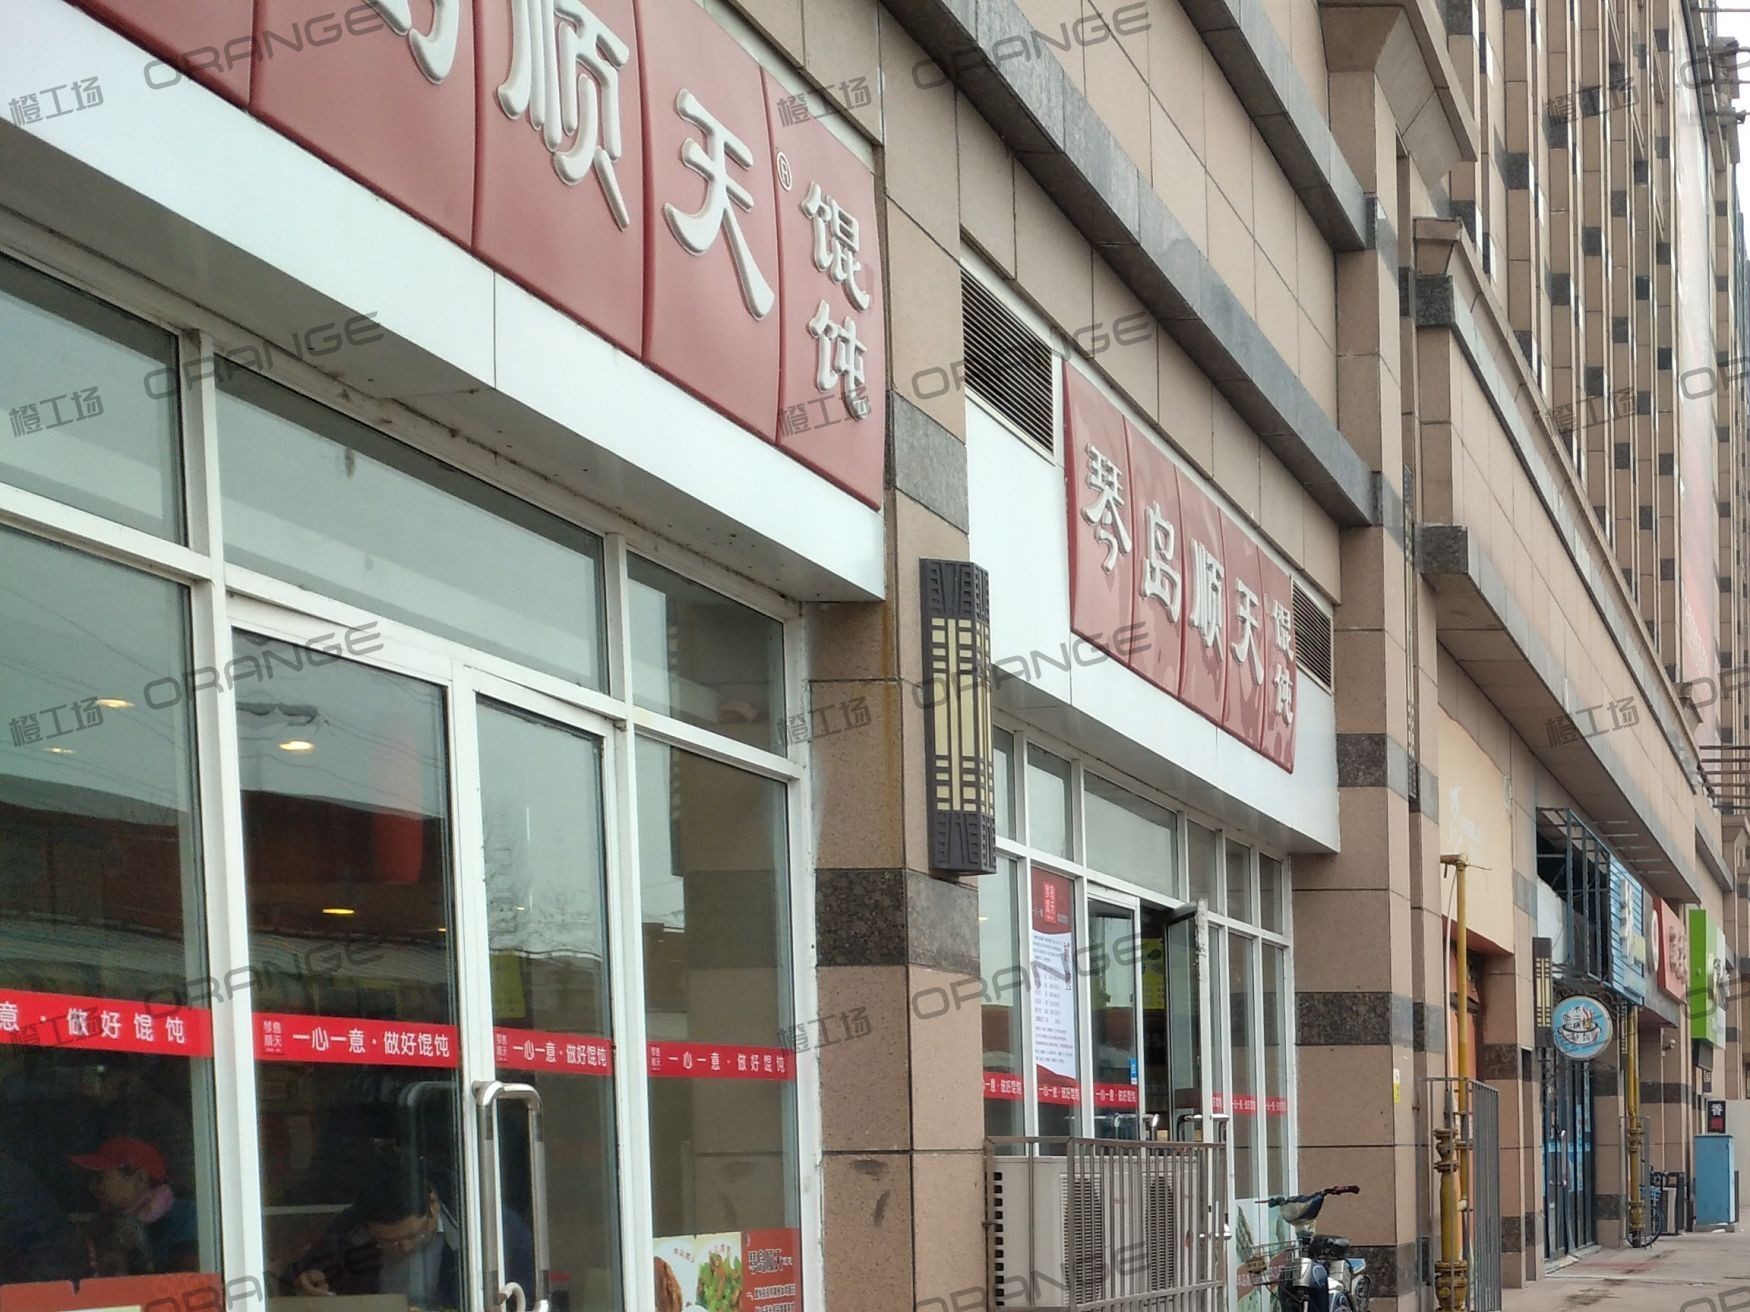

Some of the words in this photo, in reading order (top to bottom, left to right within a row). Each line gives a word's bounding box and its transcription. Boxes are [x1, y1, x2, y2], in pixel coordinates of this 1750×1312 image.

[801, 181, 872, 422] 馄饨
[1081, 442, 1265, 686] 琴岛顺天
[1270, 599, 1295, 726] 馄饨
